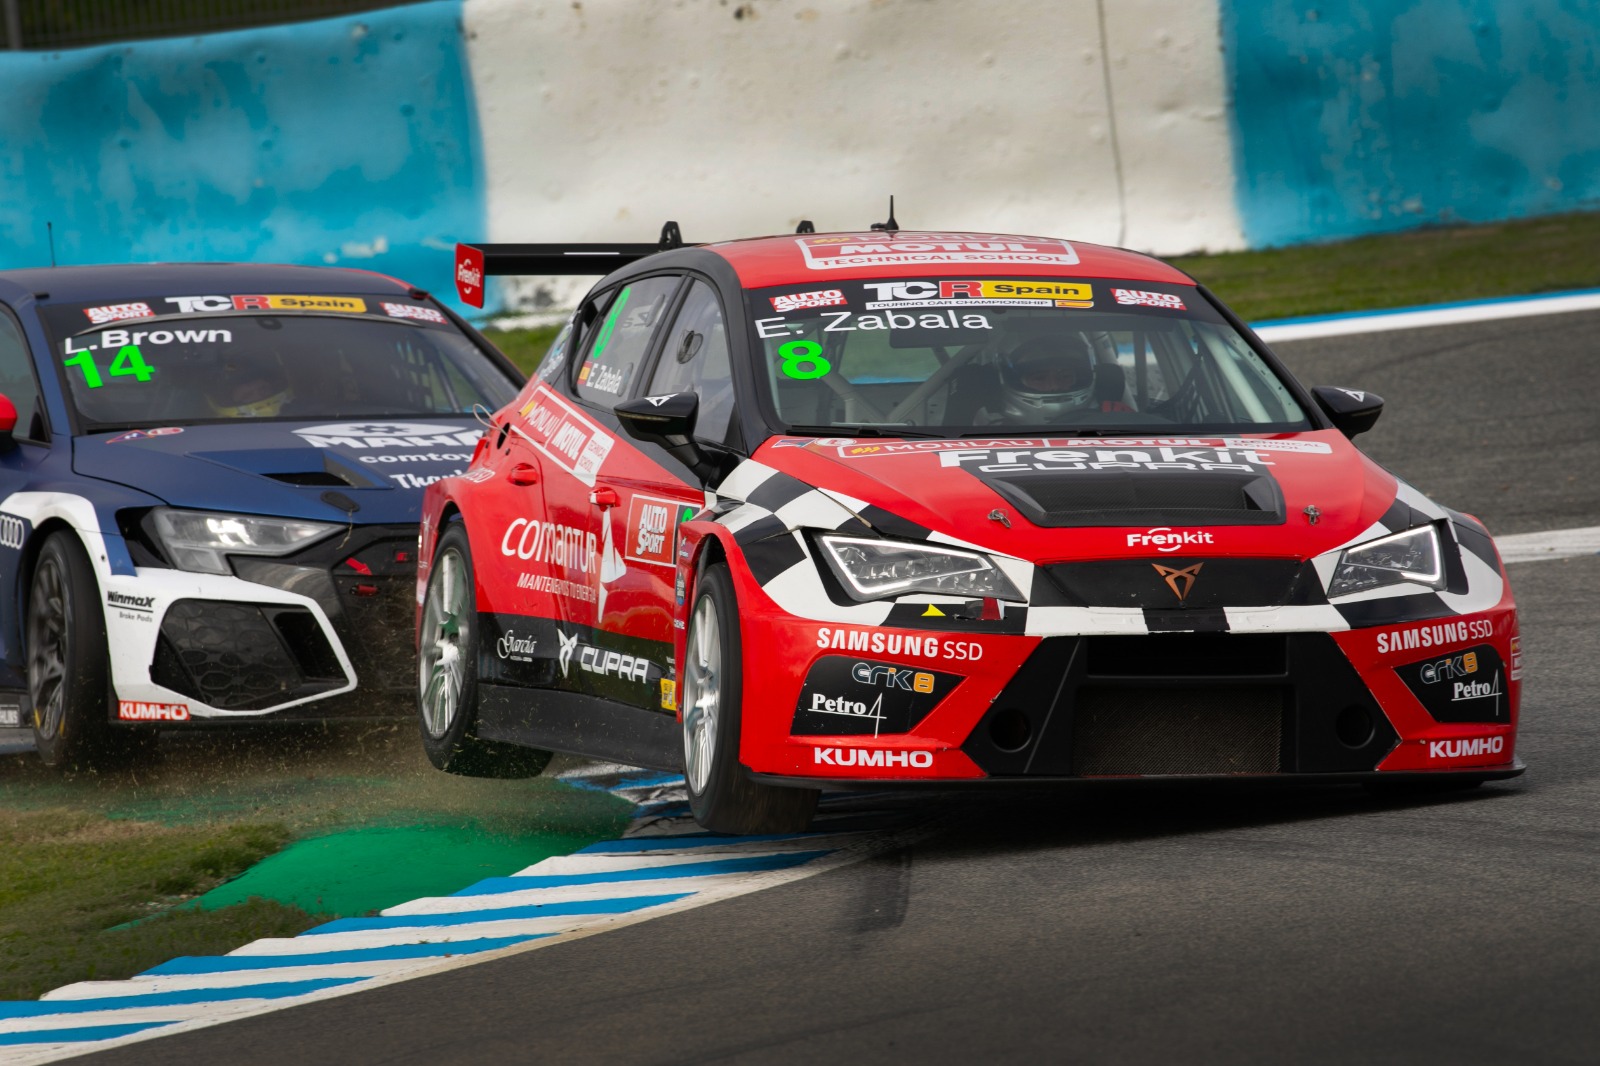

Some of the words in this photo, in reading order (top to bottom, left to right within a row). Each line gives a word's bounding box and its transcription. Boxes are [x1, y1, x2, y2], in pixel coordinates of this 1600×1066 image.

[840, 242, 1038, 255] MOTUL
[820, 255, 952, 267] TECHNICAL
[964, 253, 1068, 264] SCHOOL
[773, 289, 842, 304] AUTO
[863, 280, 983, 301] TCR
[993, 284, 1080, 296] Spain
[1115, 288, 1182, 303] AUTO
[87, 302, 149, 316] AUTO
[165, 294, 271, 312] TCR
[280, 298, 354, 309] Spain
[383, 302, 441, 315] AUTO
[776, 298, 844, 313] SPORT
[1117, 297, 1184, 309] SPORT
[755, 316, 803, 338] E.
[820, 309, 992, 331] Zabala
[63, 344, 156, 389] 14
[777, 339, 832, 380] 8
[524, 402, 561, 438] MONLAU
[550, 420, 588, 460] MOTUL
[885, 439, 1035, 452] MONLAU
[1067, 437, 1212, 446] MOTUL
[939, 446, 1276, 468] Frenkit
[978, 460, 1256, 473] CUPRA
[638, 503, 668, 533] AUTO
[635, 527, 666, 556] SPORT
[1126, 531, 1215, 547] Frenkit
[816, 627, 939, 658] SAMSUNG
[942, 640, 983, 661] SSD
[1376, 621, 1468, 654] SAMSUNG
[1469, 619, 1494, 640] SSD
[580, 645, 650, 684] CUPRA
[120, 701, 188, 720] KUMHO
[1429, 735, 1504, 758] KUMHO
[814, 747, 934, 768] KUMHO
